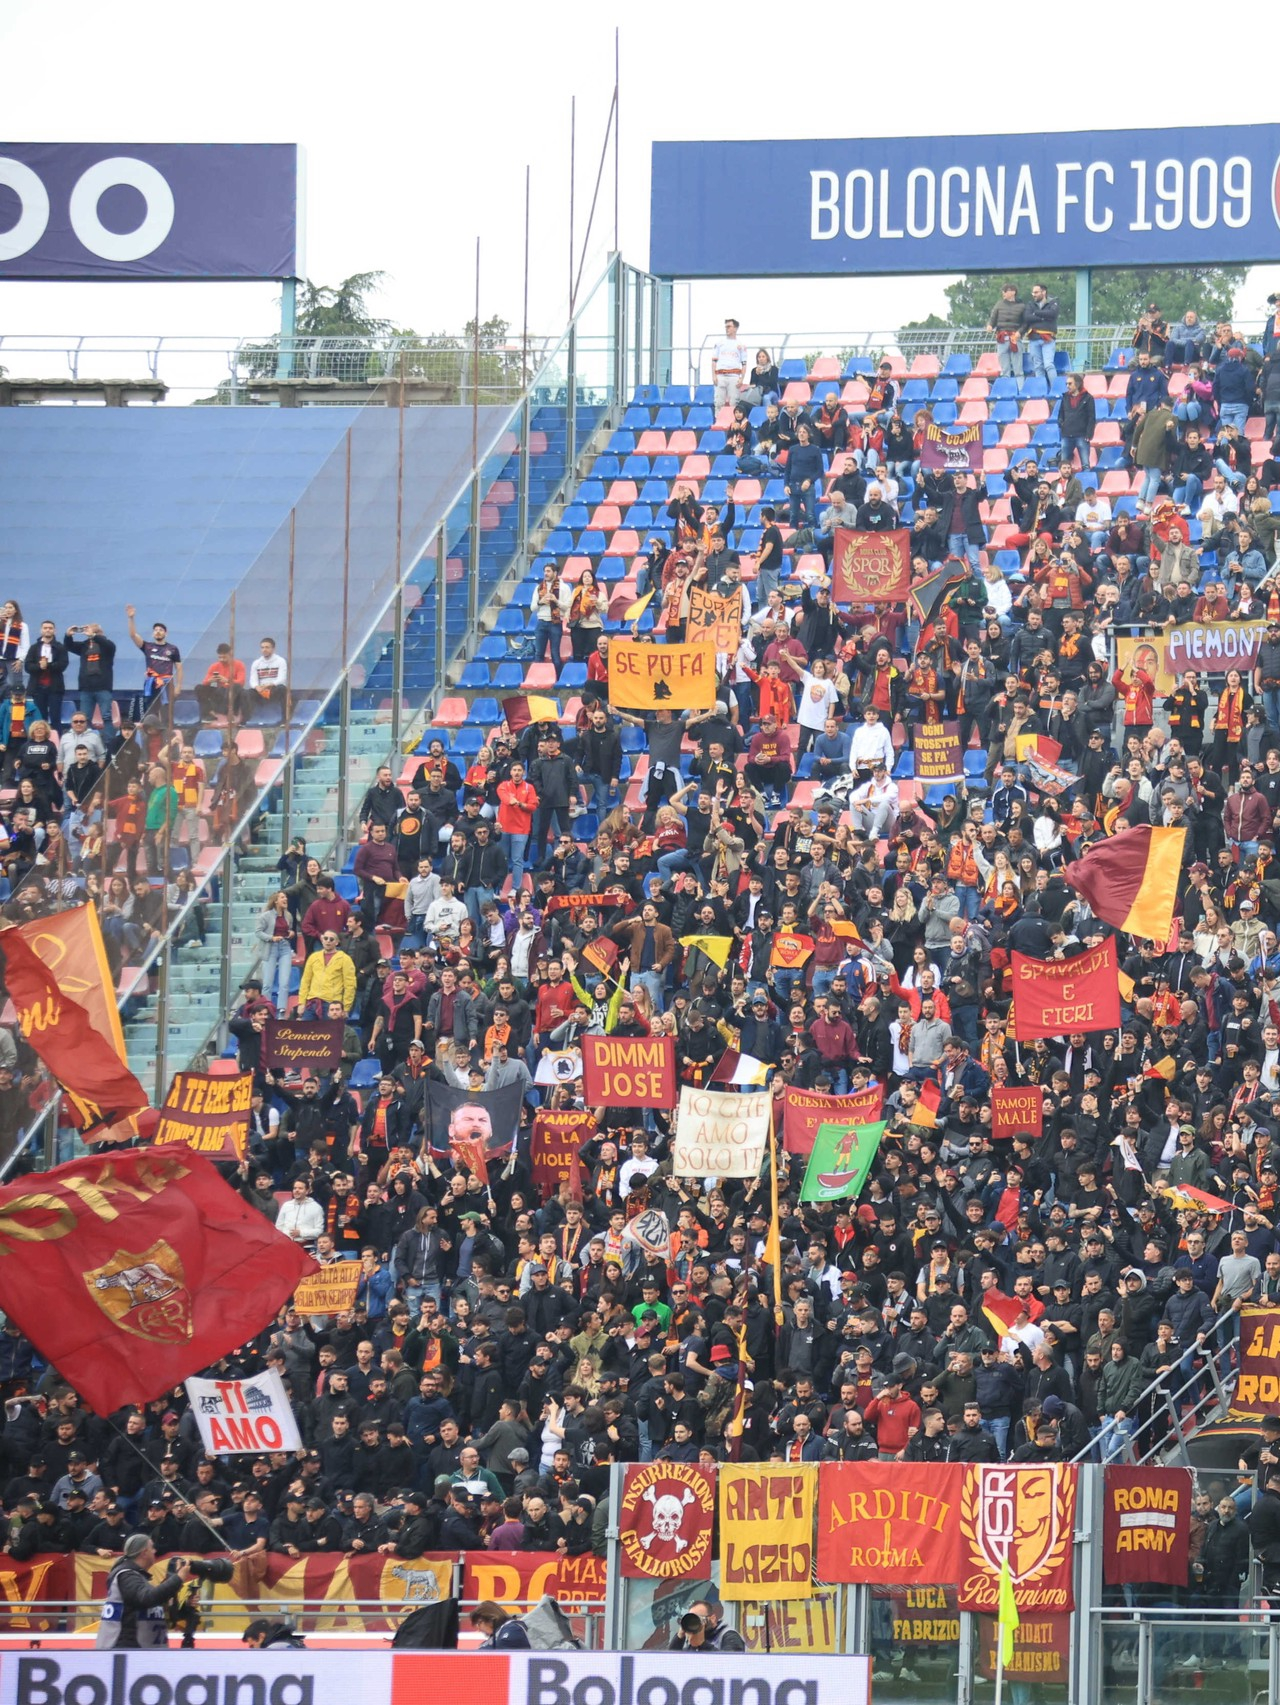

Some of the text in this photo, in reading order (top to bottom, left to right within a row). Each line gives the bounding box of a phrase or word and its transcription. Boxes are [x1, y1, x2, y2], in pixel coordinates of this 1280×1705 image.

[810, 156, 1253, 241] BOLOGNA FC 1909
[852, 557, 893, 576] SPQR
[616, 652, 641, 675] SE
[922, 724, 944, 737] OGNI
[921, 752, 933, 763] SE
[920, 763, 955, 776] ARDITA!
[1020, 949, 1110, 980] SPAVALDI
[1062, 983, 1076, 1001] E
[1042, 1003, 1094, 1026] FIERI
[276, 1028, 332, 1041] Pensiero
[274, 1044, 332, 1061] Stupendo
[594, 1041, 665, 1068] DIMMI
[166, 1075, 182, 1109] A
[182, 1078, 208, 1114] TE
[687, 1093, 764, 1118] IO CHE
[788, 1093, 879, 1109] QUESTA MAGLIA
[995, 1097, 1037, 1109] FAMOJE
[997, 1110, 1038, 1126] MALE
[544, 1130, 580, 1144] E LA
[695, 1122, 748, 1144] AMO
[676, 1147, 734, 1171] SOLO
[215, 1381, 249, 1414] TI
[210, 1415, 283, 1451] AMO
[622, 1463, 715, 1514] INSURREZIONE
[1114, 1486, 1179, 1512] ROMA
[828, 1488, 951, 1534] ARDITI
[984, 1471, 1016, 1562] ASR
[1116, 1528, 1177, 1553] ARMY
[621, 1527, 712, 1578] GIALLOROSSA
[850, 1547, 924, 1569] ROMA
[906, 1588, 947, 1609] LUCA
[893, 1619, 961, 1641] FABRIZIO
[17, 1655, 314, 1705] Bologna
[529, 1657, 820, 1705] Bologna
